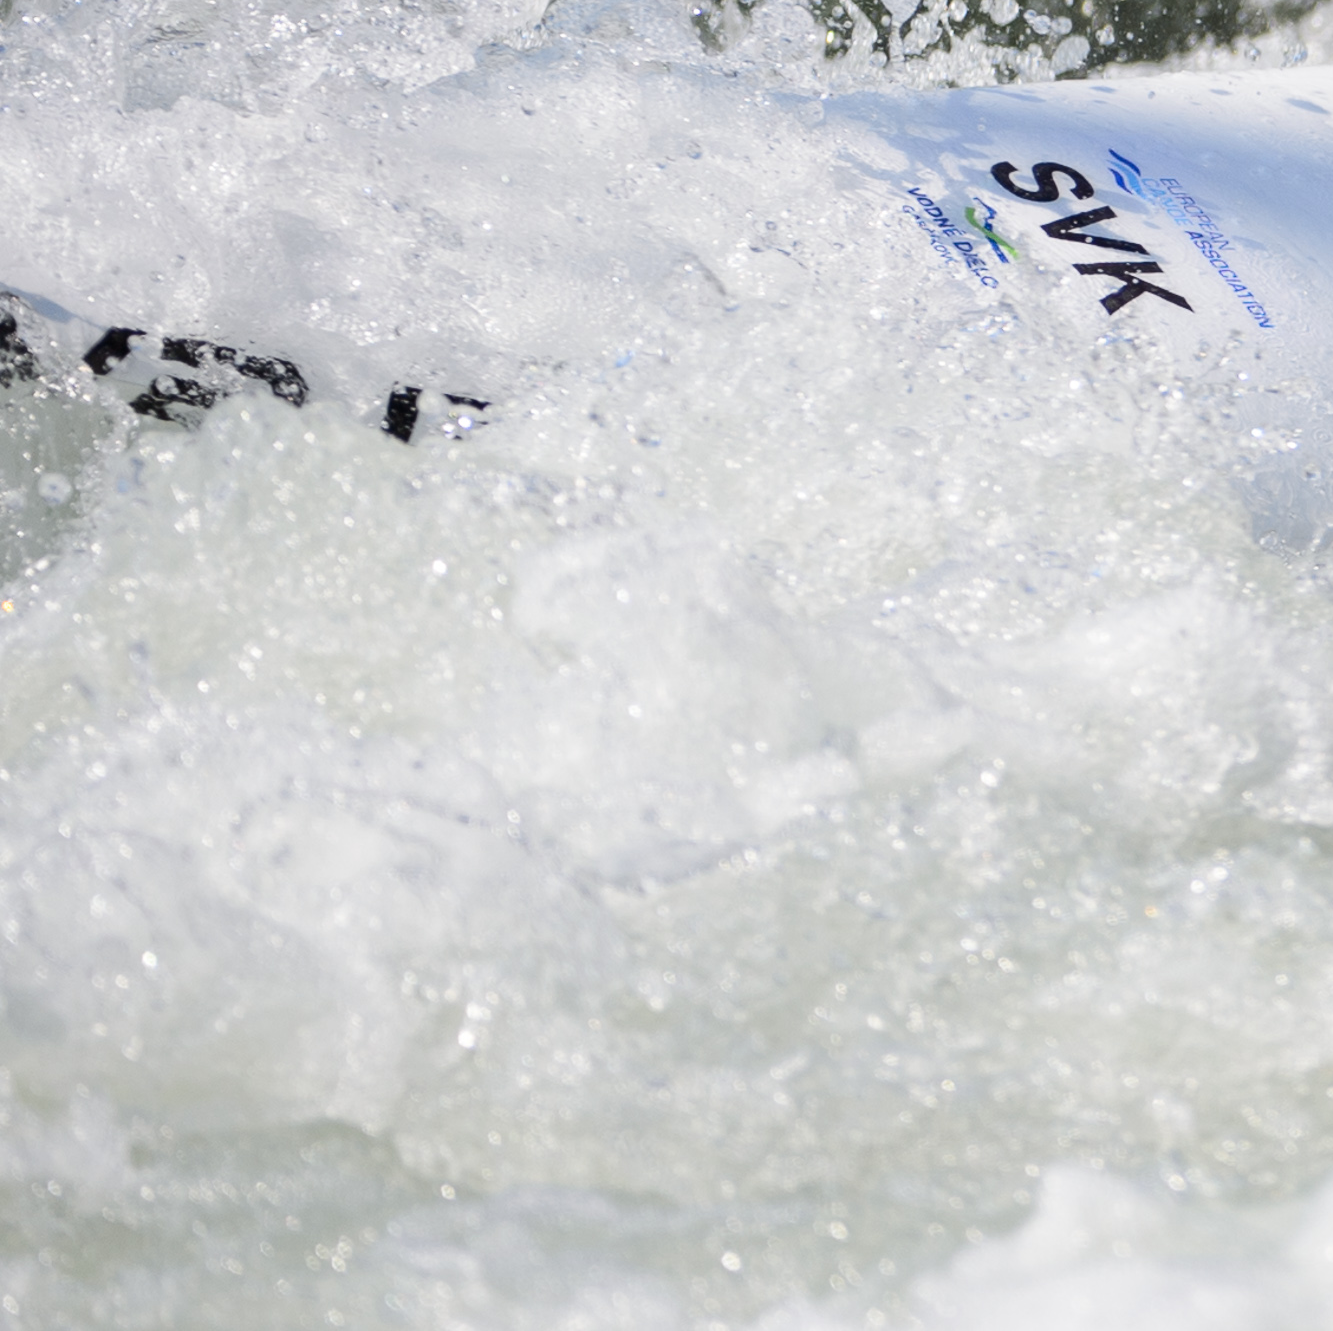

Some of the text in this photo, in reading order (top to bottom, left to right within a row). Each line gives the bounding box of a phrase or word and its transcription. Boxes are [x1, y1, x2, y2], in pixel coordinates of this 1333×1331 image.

[907, 187, 967, 238] VODNÉ
[990, 161, 1195, 316] SVK
[1141, 177, 1276, 329] CANOE ASSOCIATION
[1159, 178, 1236, 251] EUROPEAN
